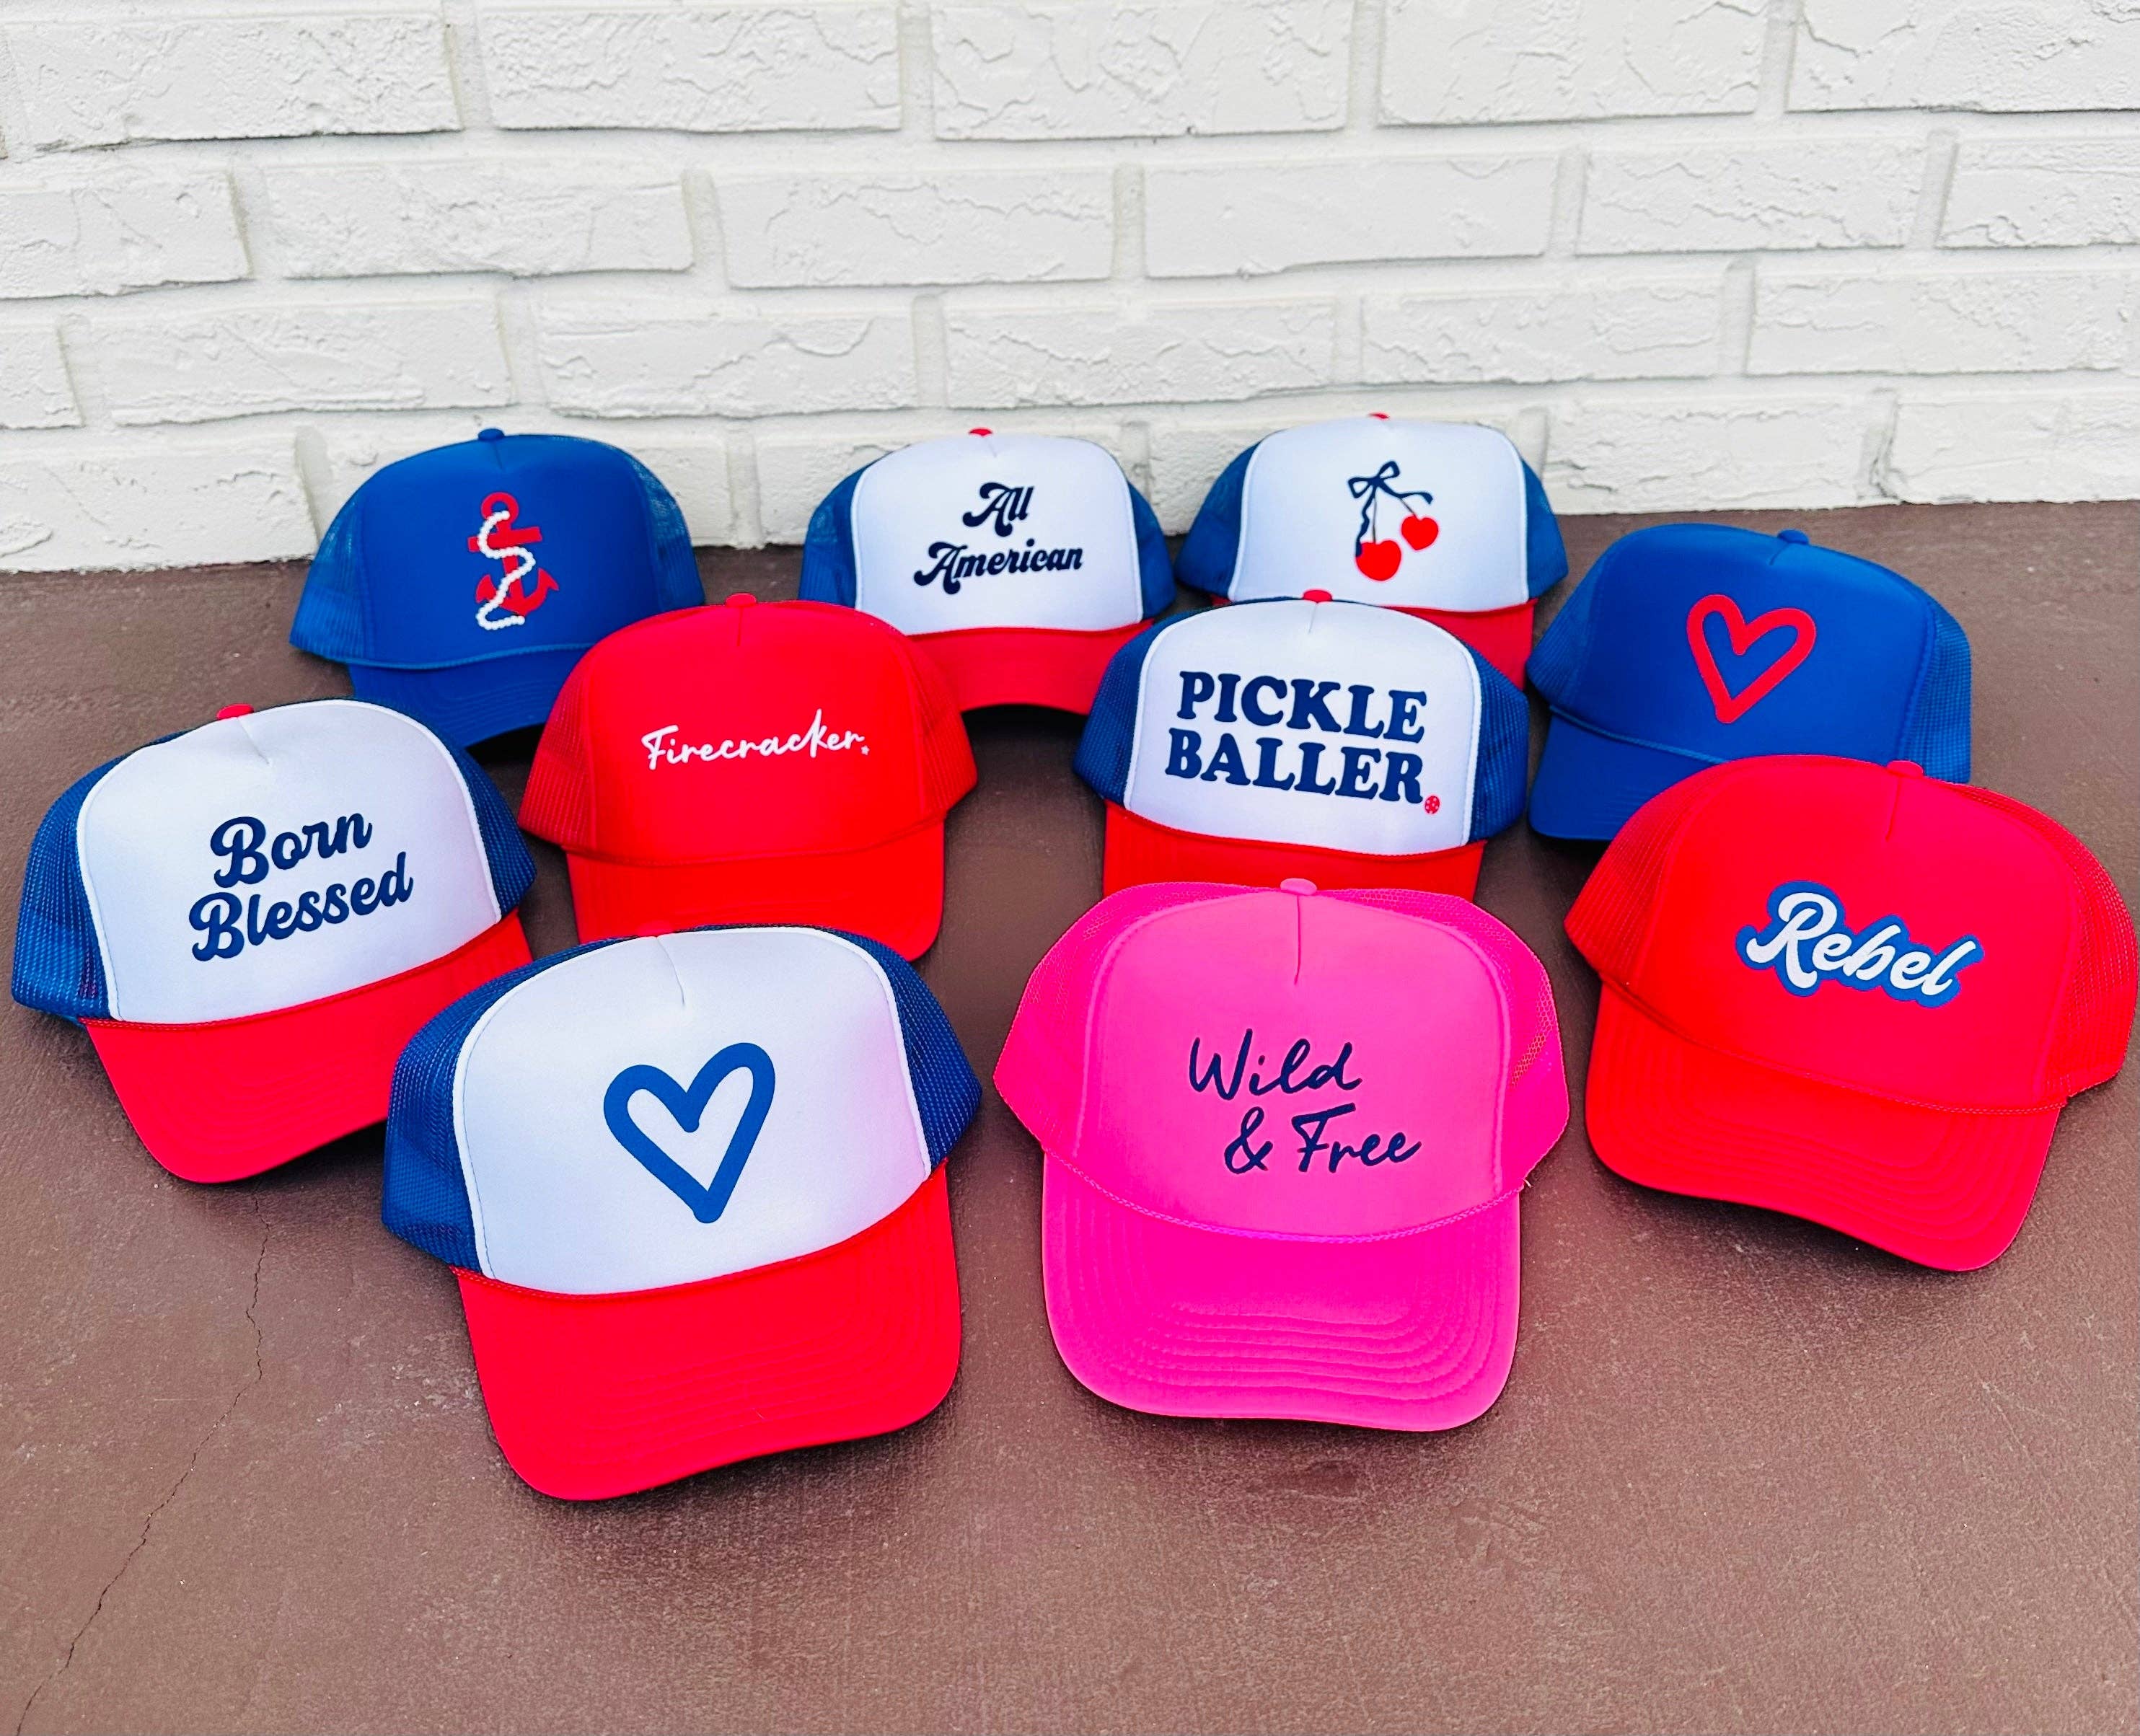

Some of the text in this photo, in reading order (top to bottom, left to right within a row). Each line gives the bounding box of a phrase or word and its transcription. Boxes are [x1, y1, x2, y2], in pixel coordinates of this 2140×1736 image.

[962, 482, 1034, 537] All
[913, 538, 1083, 594] American
[1176, 671, 1427, 744] PICKLE
[210, 813, 372, 888] Born
[188, 851, 413, 961] Blessed
[1745, 892, 1976, 995] Rebel
[1189, 1028, 1362, 1100] Wild
[1224, 1102, 1422, 1174] & Free
